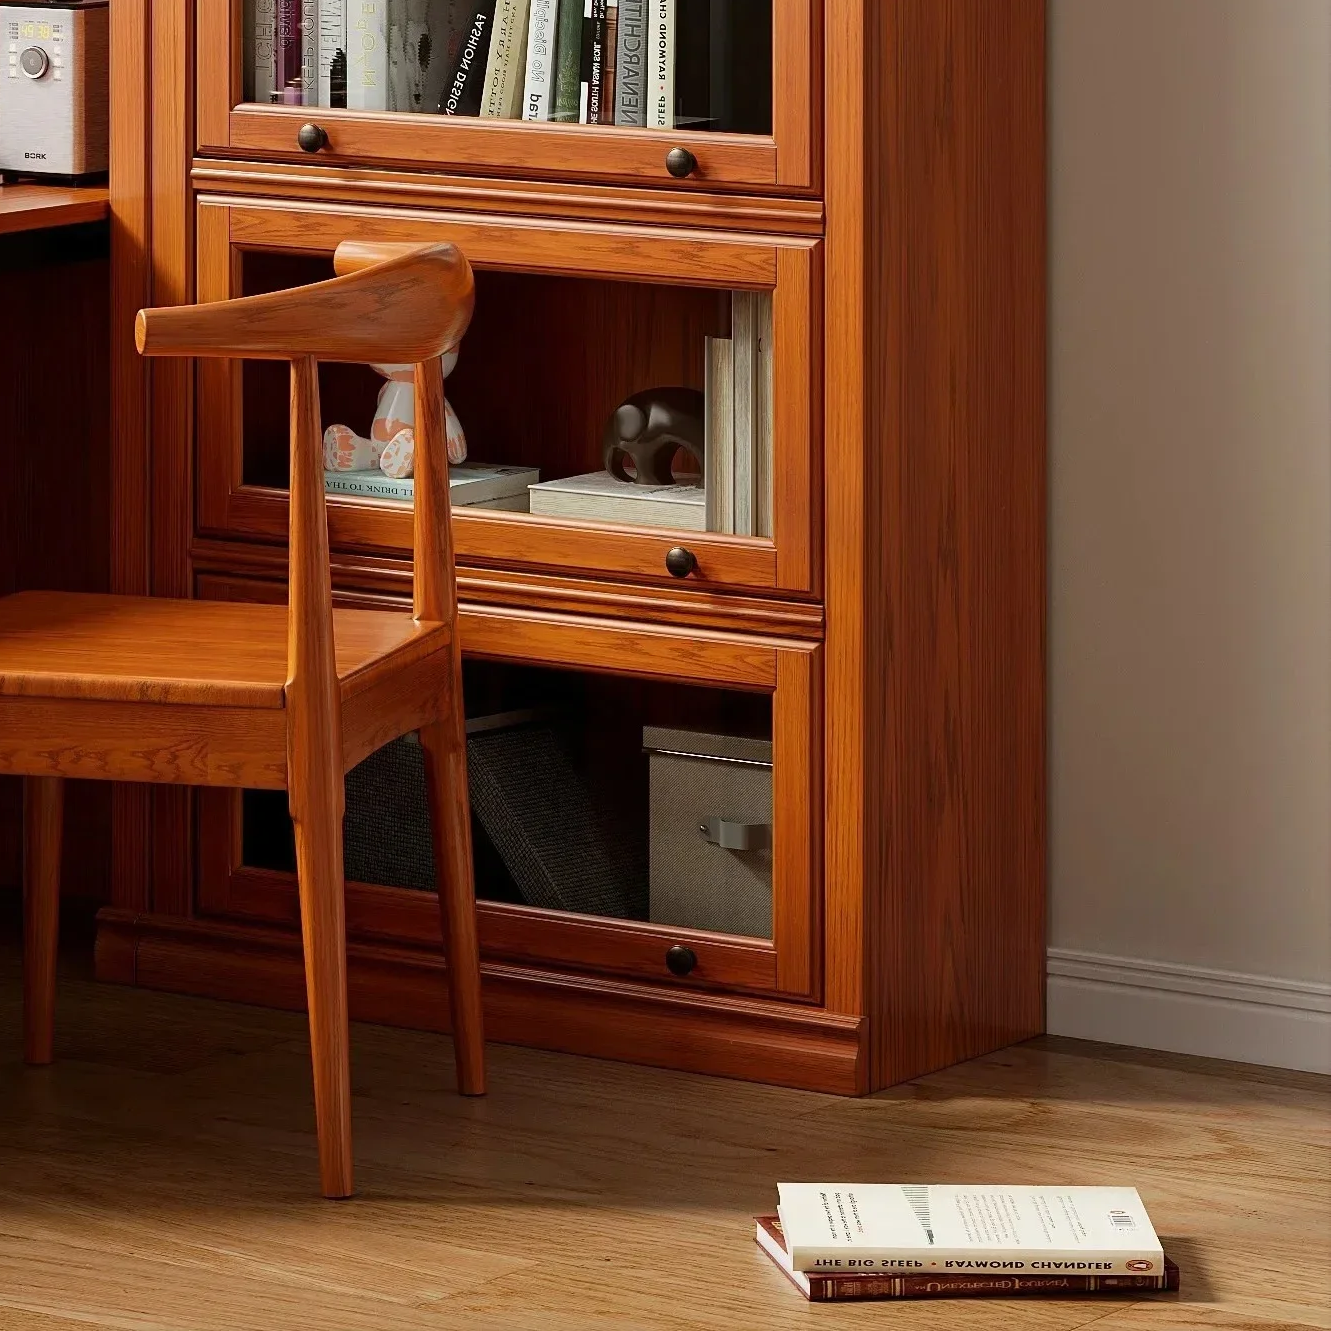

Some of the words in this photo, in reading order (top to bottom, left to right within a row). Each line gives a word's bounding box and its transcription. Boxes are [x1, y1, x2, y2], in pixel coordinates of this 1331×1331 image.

[24, 152, 47, 160] BORK
[349, 483, 363, 492] TO
[366, 485, 398, 495] DRINK
